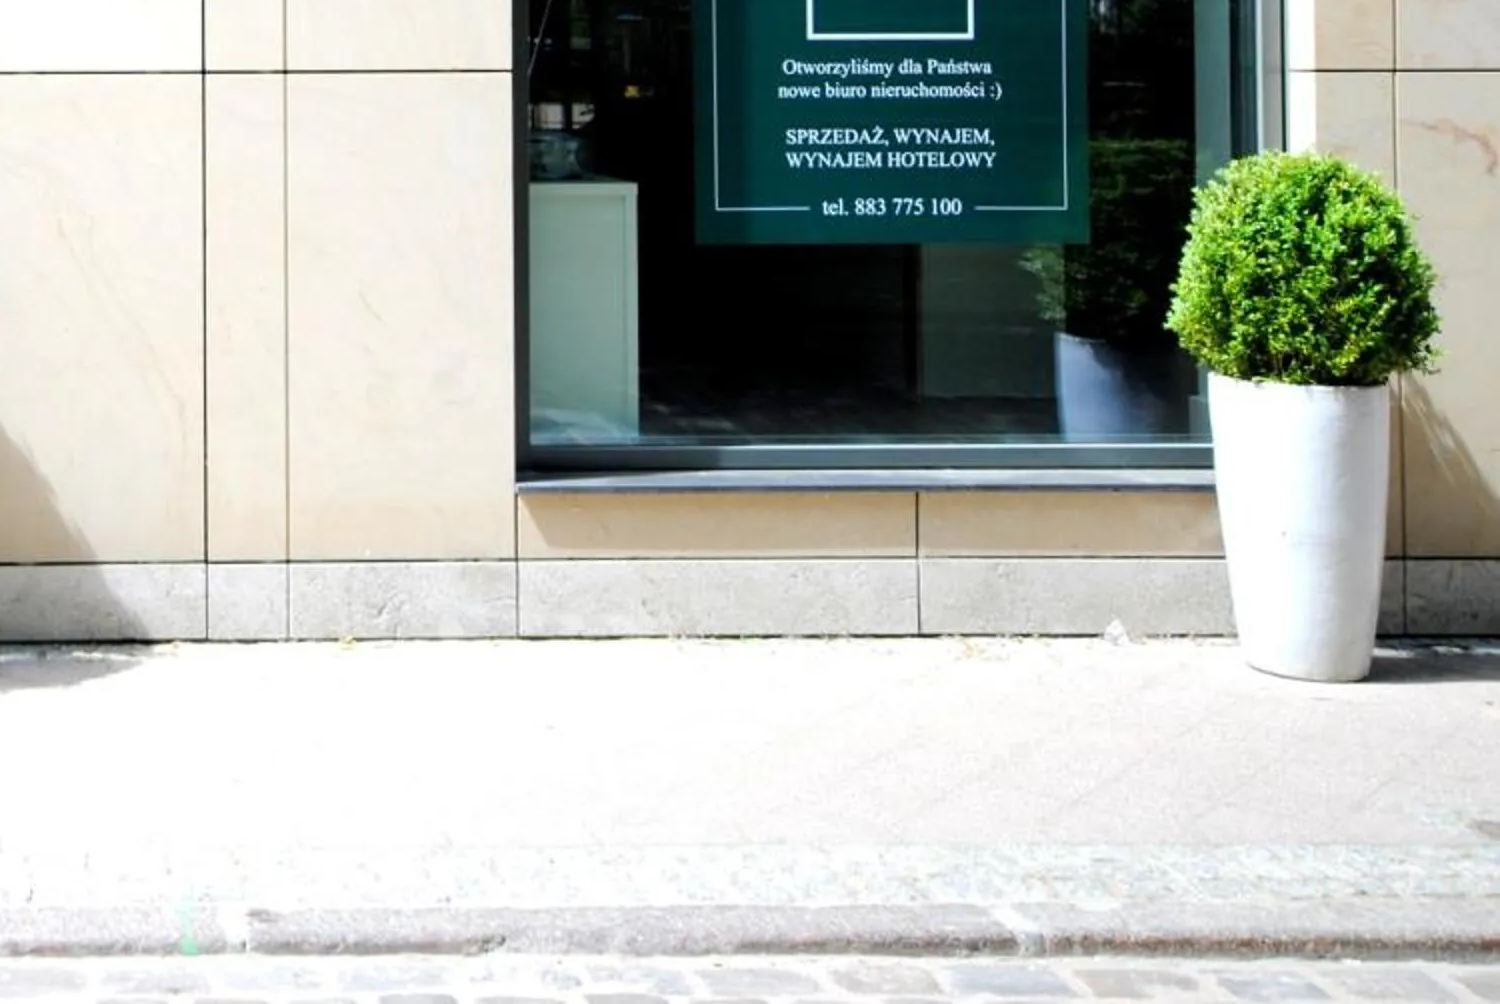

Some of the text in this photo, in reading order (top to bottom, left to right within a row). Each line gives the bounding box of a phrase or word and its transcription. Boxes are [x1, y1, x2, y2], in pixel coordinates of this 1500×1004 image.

[781, 58, 992, 79] Otworzyliśmy dla Państwa
[777, 85, 821, 99] nowe
[824, 81, 867, 99] biuro
[870, 81, 985, 98] nieruchomości
[785, 125, 995, 147] SPRZEDAŻ, WYNAJEM,
[785, 151, 997, 169] WYNAJEM HOTELOWY
[821, 197, 963, 216] tel. 883 775 100
